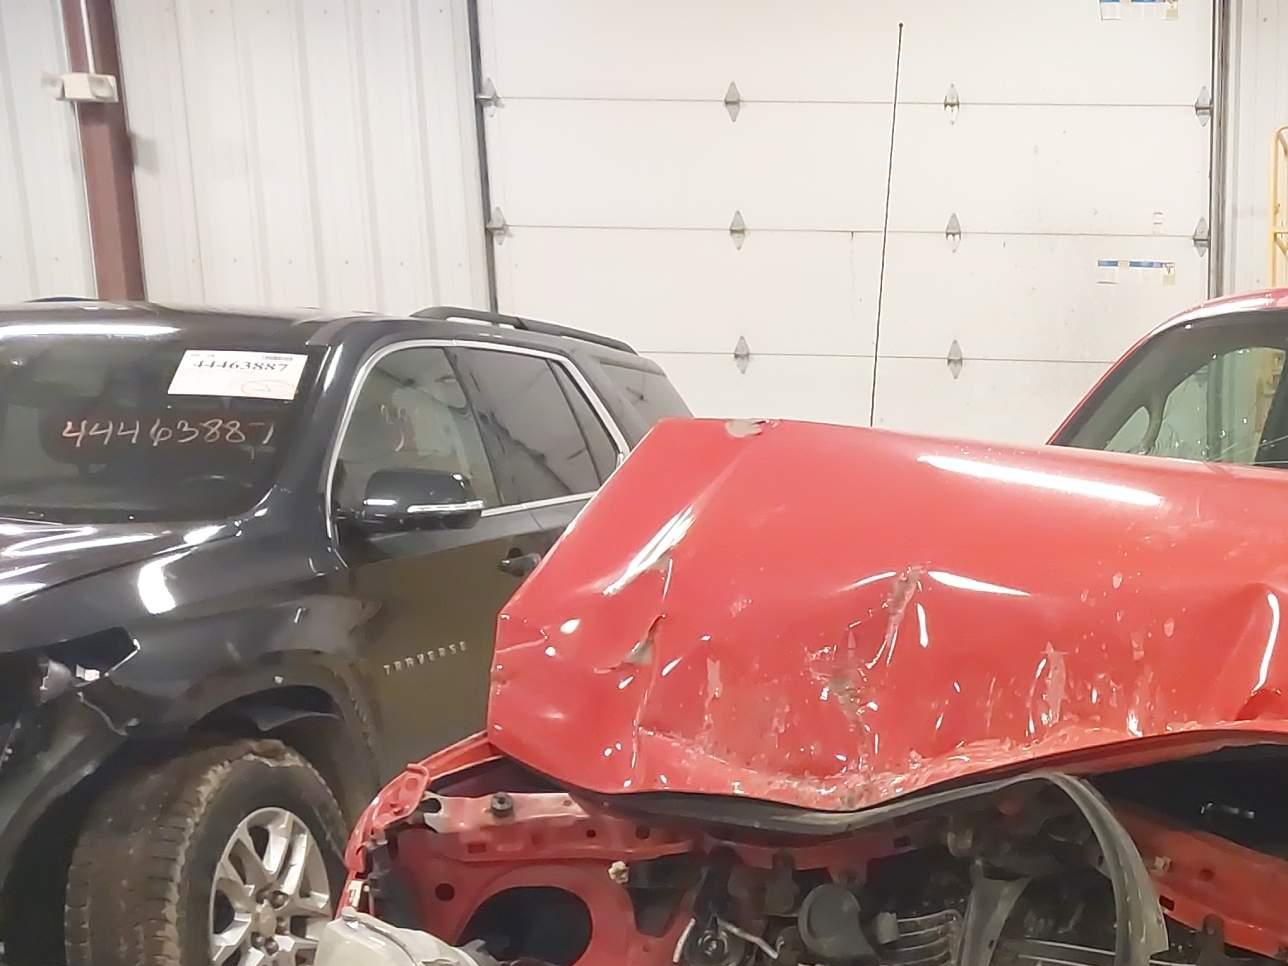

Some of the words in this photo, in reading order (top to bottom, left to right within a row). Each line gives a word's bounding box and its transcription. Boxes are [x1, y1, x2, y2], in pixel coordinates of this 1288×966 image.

[193, 360, 289, 372] 44463887
[62, 418, 274, 447] 44463887
[383, 641, 466, 675] TRAVERSE
